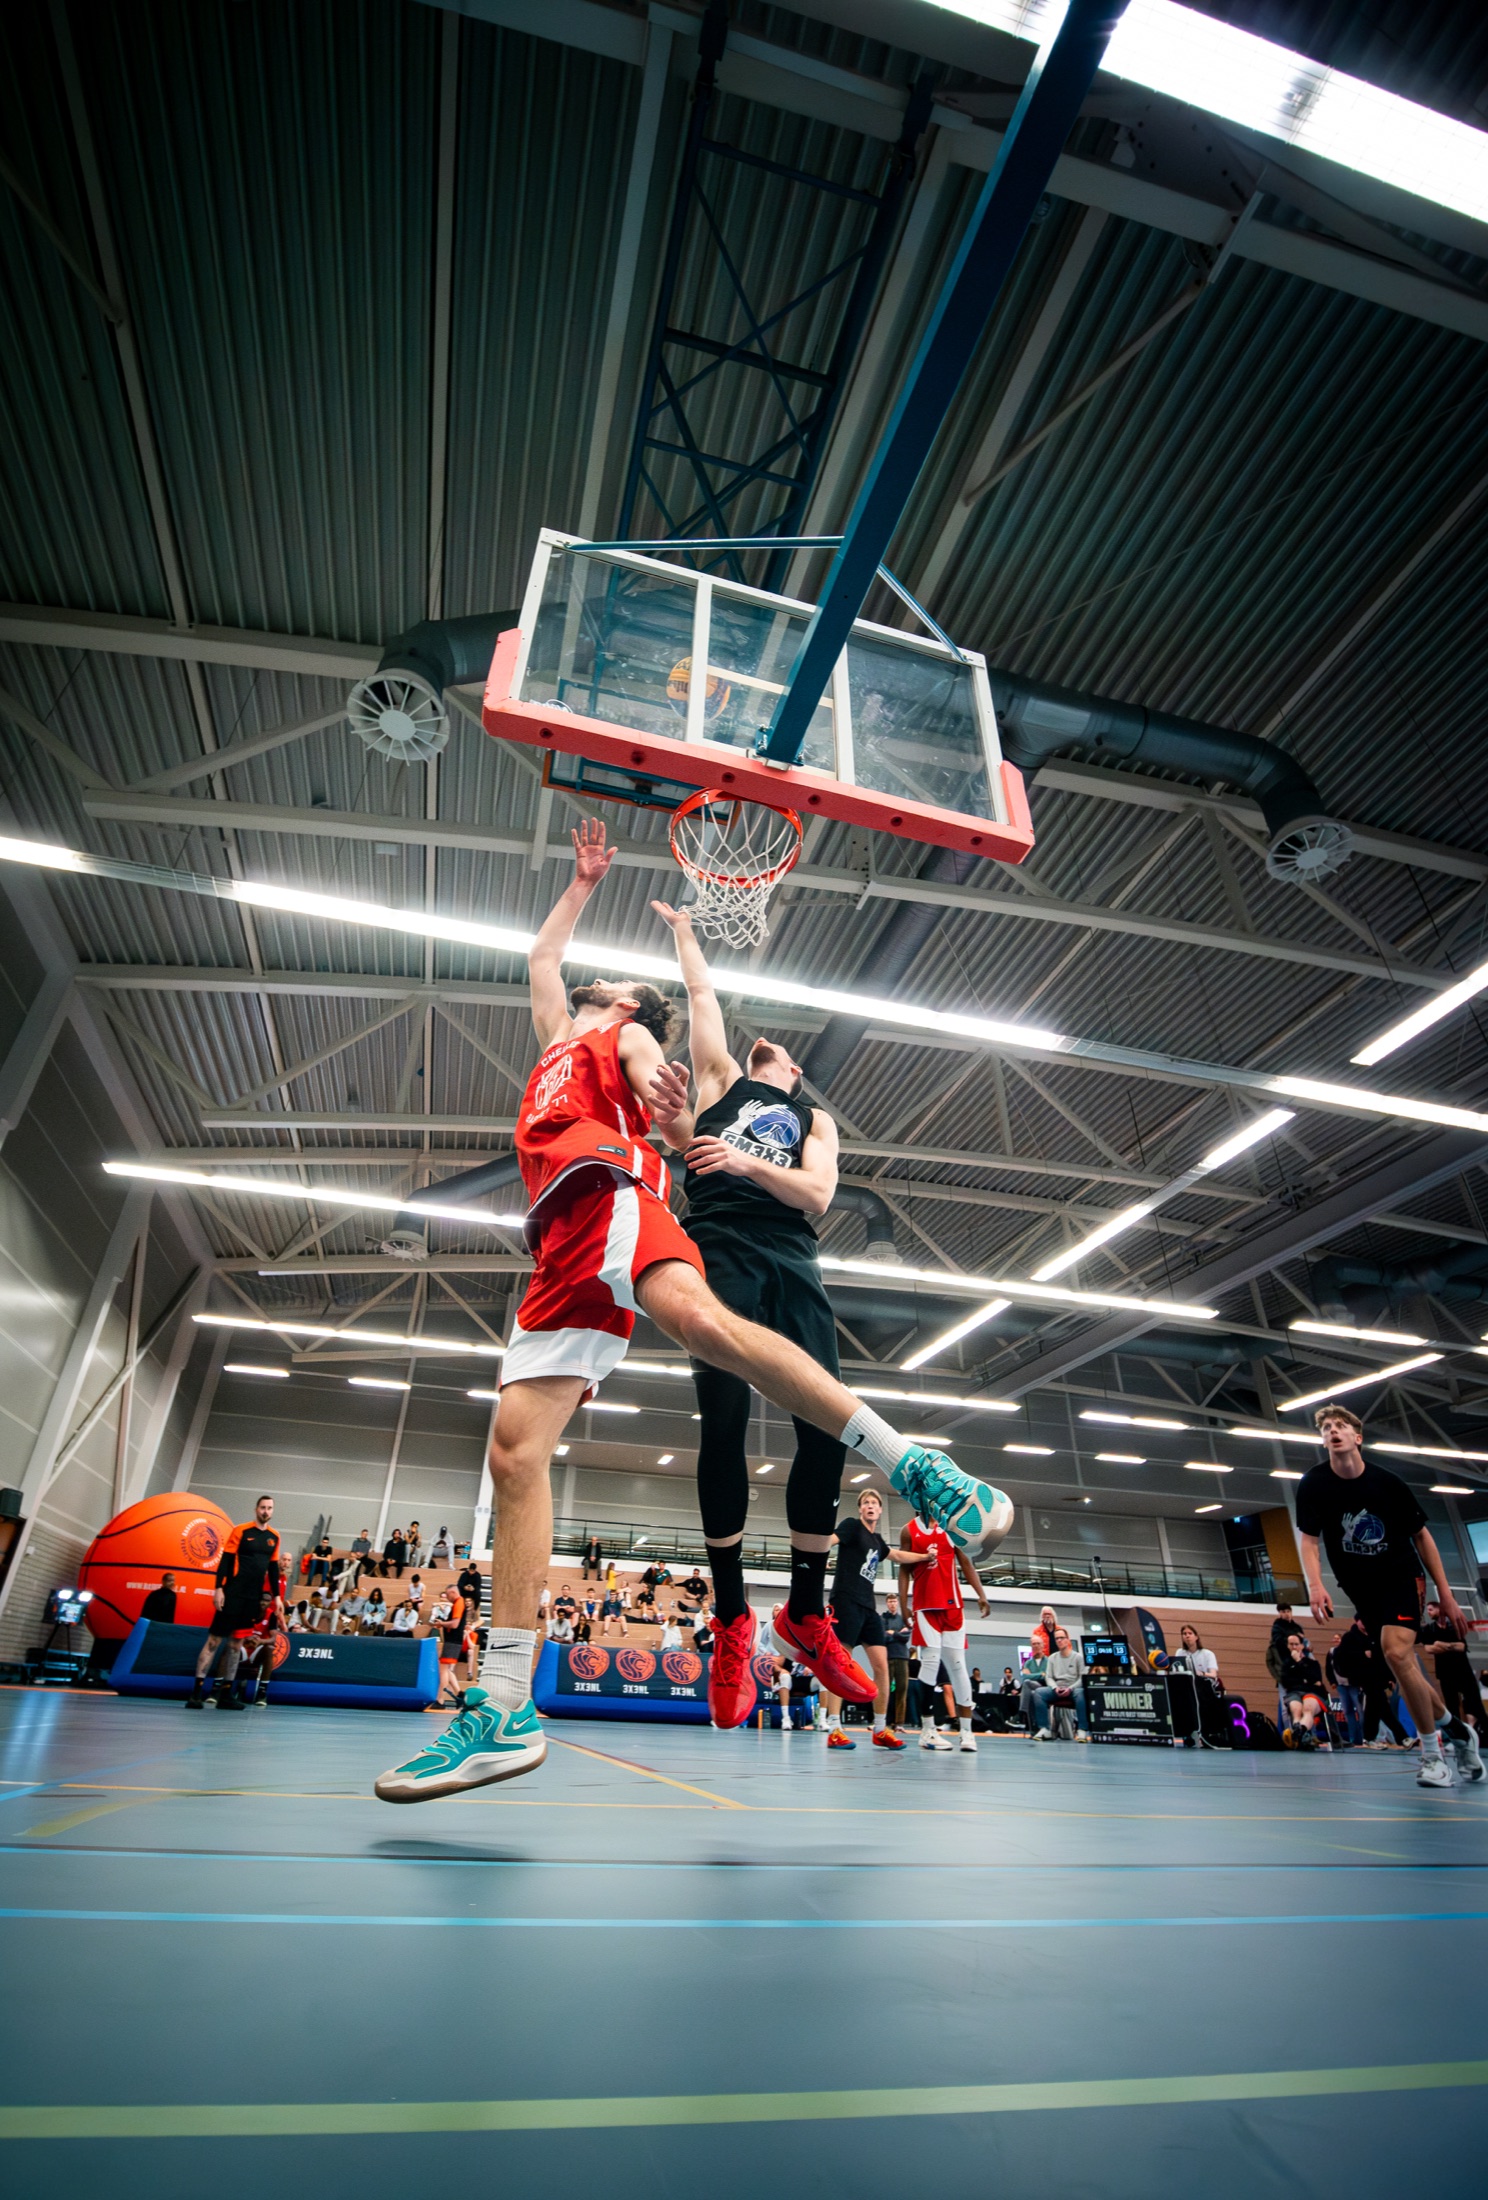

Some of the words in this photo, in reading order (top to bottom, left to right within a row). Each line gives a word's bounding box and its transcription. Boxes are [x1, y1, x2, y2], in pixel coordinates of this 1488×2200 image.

[724, 1134, 789, 1168] GM3X3
[298, 1647, 334, 1660] 3X3NL
[574, 1682, 602, 1693] 3X3NL
[622, 1684, 650, 1695] 3X3NL
[670, 1687, 698, 1697] 3X3NL
[1103, 1692, 1154, 1710] WINNER
